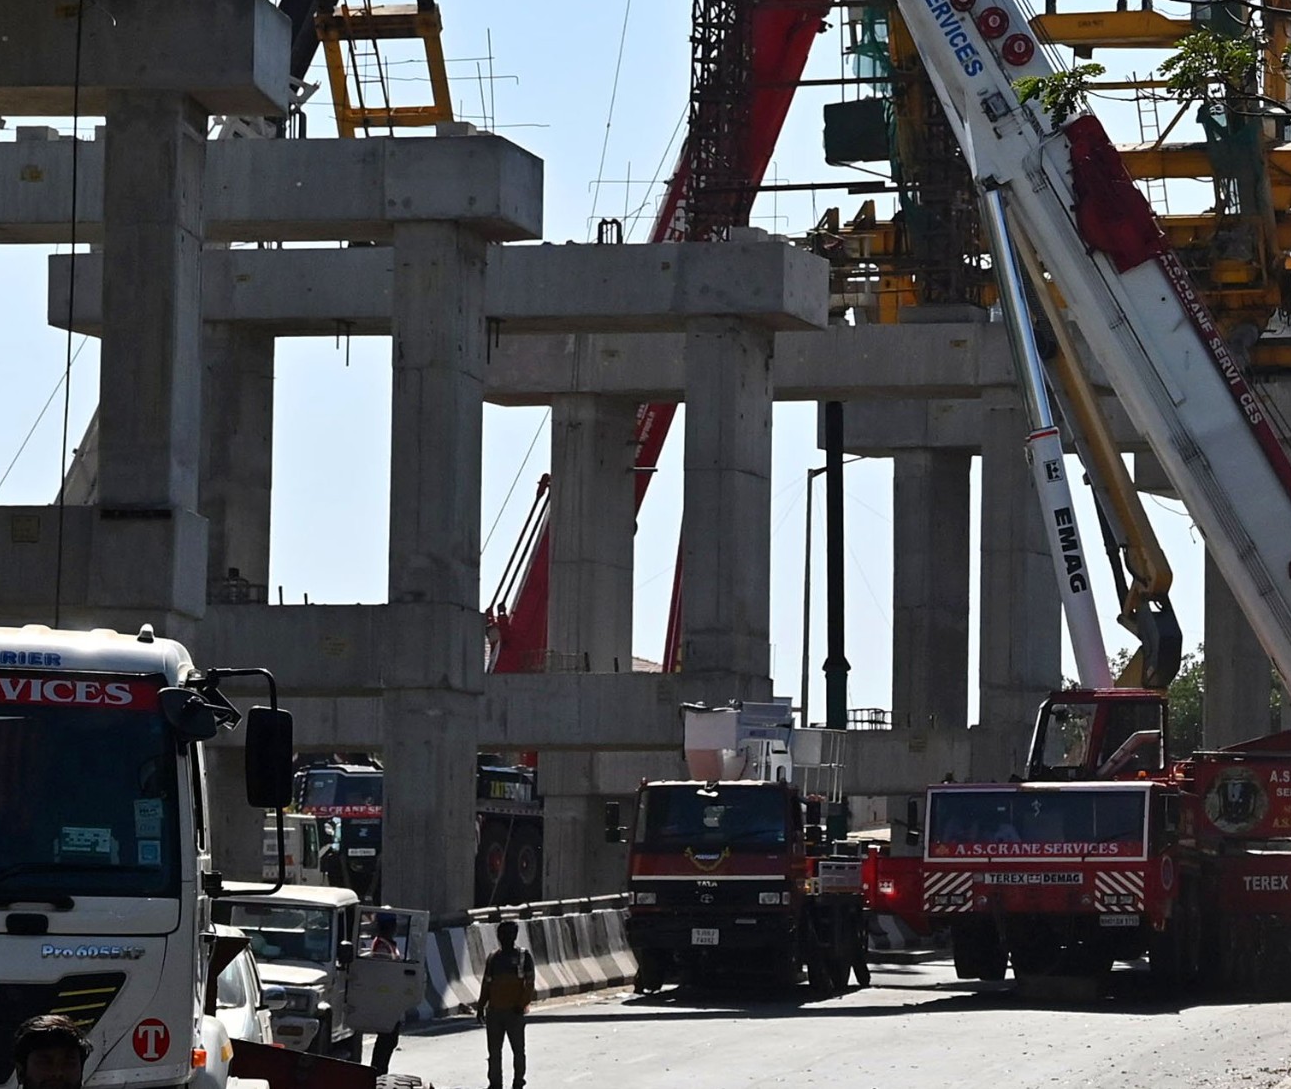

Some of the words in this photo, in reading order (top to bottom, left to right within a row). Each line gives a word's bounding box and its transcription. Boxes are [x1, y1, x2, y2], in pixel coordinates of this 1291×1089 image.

[955, 842, 1040, 856] A.S.CRANE
[1044, 842, 1119, 855] SERVICES
[697, 880, 718, 888] TATA
[990, 873, 1025, 884] TEREX
[1043, 873, 1080, 884] DEMAG
[1243, 875, 1289, 891] TEREX
[41, 943, 72, 958] Pro
[138, 1025, 165, 1059] T
